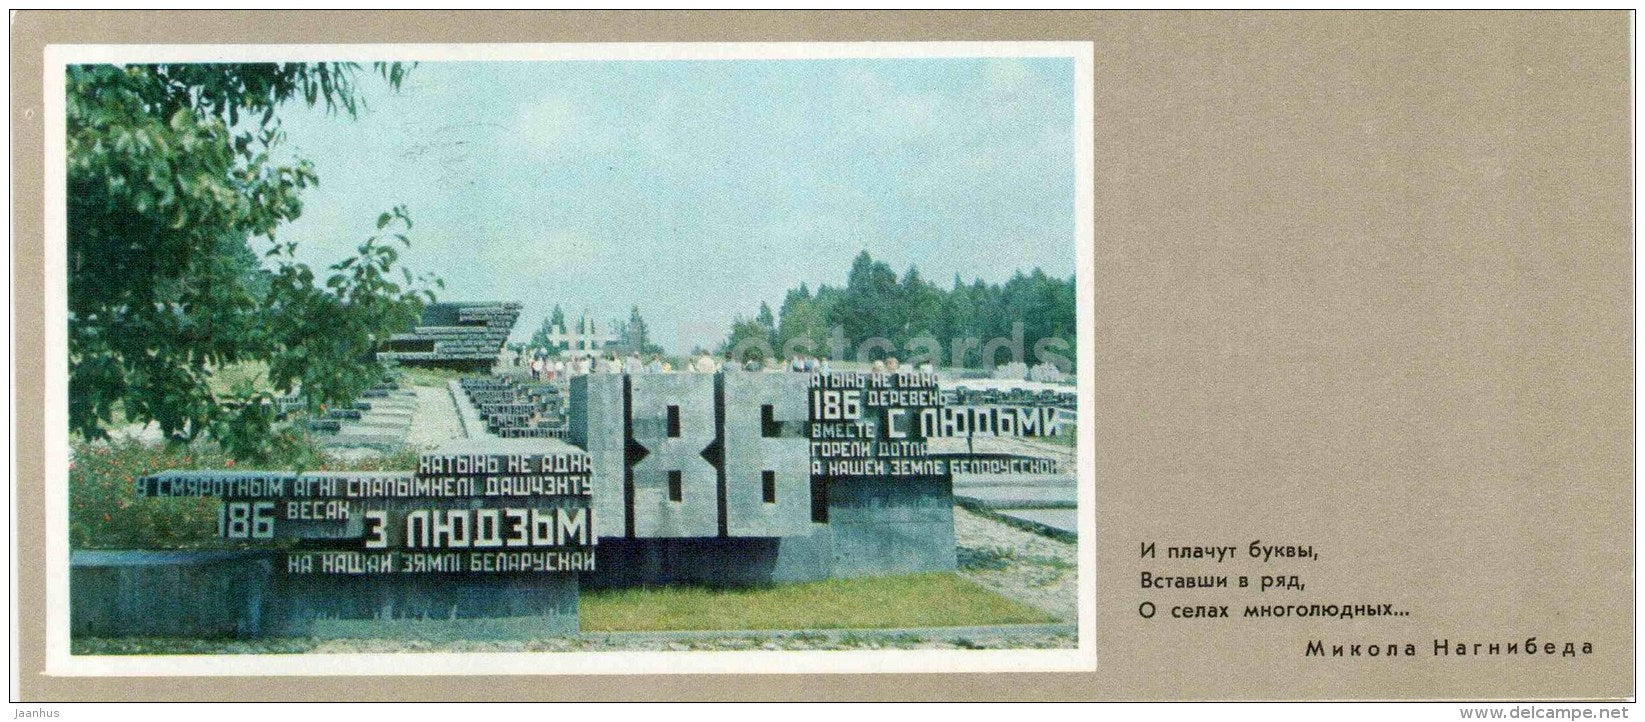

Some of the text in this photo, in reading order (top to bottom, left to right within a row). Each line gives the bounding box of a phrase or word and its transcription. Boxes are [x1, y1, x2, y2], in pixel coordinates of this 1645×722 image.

[811, 372, 865, 388] АТЫНЬ
[872, 372, 893, 388] НЕ
[814, 389, 861, 420] 186
[868, 390, 947, 406] ДЕРЕВЕНЬ
[811, 422, 876, 438] ВМЕСТЕ
[887, 406, 1063, 438] С ЛЮДЬМИ
[587, 373, 812, 537] 186
[811, 441, 928, 457] ГОРЕЛИ ДОТЛА
[419, 454, 593, 474] ХАТЫНЬ НЕ АДНА
[811, 461, 821, 475] А
[890, 460, 944, 475] ЗЕМЛЕ
[485, 476, 592, 496] ДАШЧЭНТУ
[287, 501, 350, 519] ВЕСАК
[218, 502, 275, 539] 186
[1140, 540, 1319, 562] И плачут буквы,
[288, 554, 313, 573] НА
[1140, 572, 1306, 592] Вставши в ряд,
[1139, 602, 1410, 619] О селах многолюдных...
[1305, 637, 1595, 656] Микола Нагнибеда
